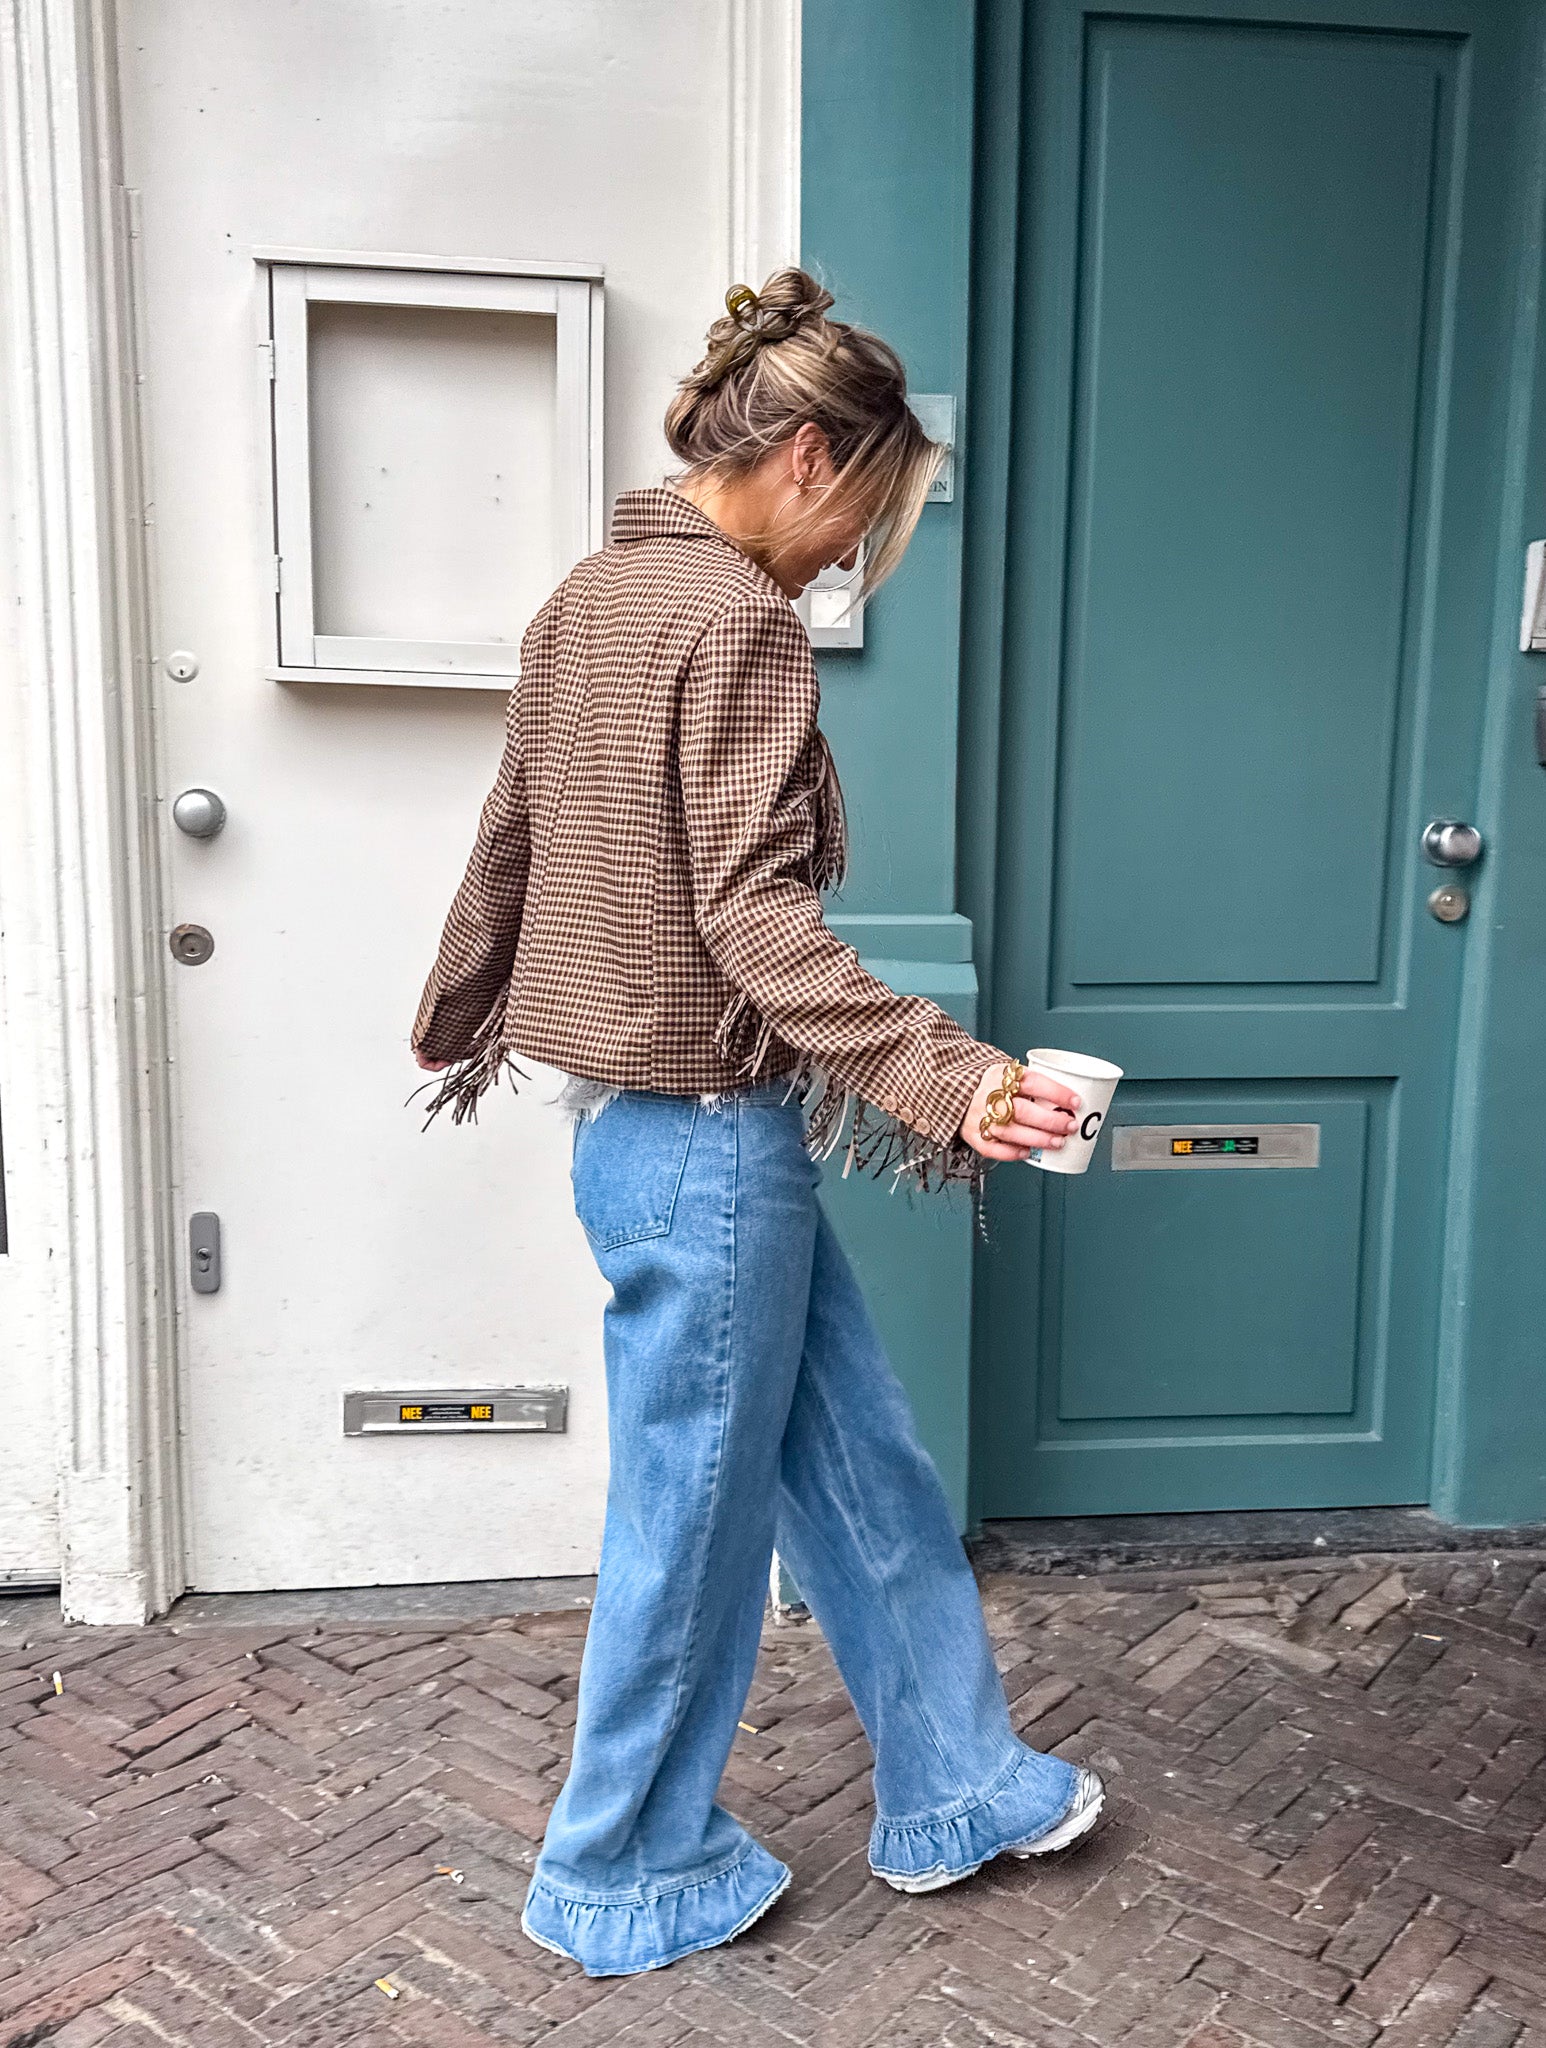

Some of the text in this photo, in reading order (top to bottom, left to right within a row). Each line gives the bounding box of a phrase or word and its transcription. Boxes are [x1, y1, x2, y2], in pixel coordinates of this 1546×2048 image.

[928, 481, 948, 492] IN
[1173, 1141, 1193, 1154] NEE
[402, 1407, 423, 1420] NEE
[471, 1406, 492, 1419] NEE
